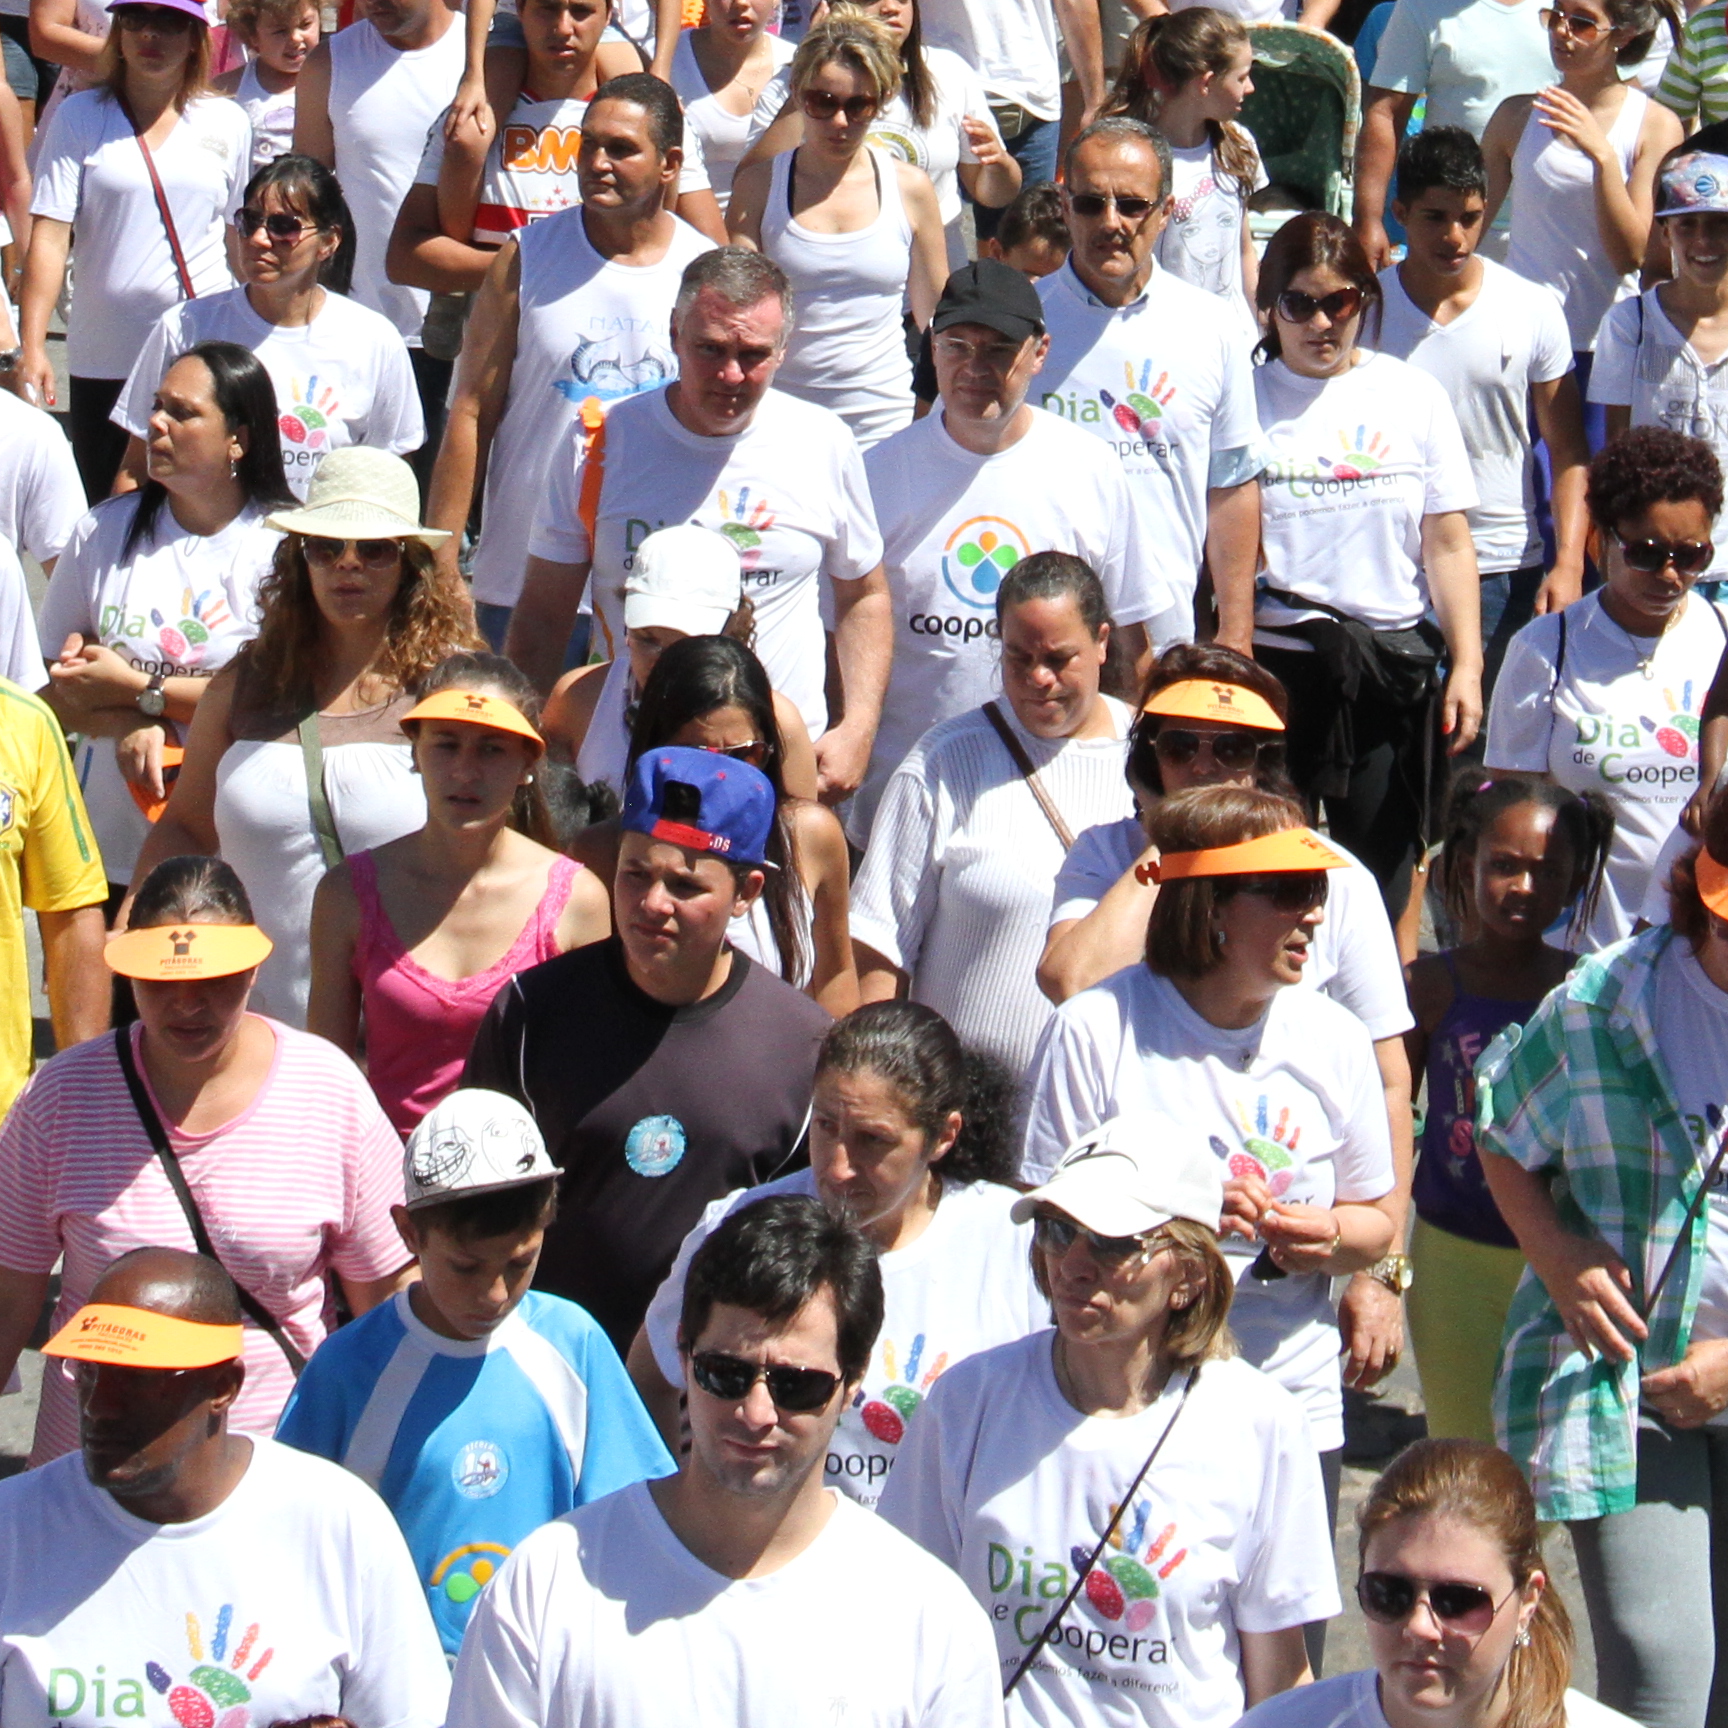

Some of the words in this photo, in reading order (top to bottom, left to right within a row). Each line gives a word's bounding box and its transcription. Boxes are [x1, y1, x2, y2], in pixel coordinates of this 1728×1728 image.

[501, 125, 582, 175] BM
[1108, 437, 1180, 459] perar
[1575, 714, 1641, 747] Dia
[1572, 750, 1595, 769] de
[1599, 752, 1703, 790] Coope
[987, 1541, 1071, 1600] Dia
[1013, 1604, 1177, 1670] Coopera
[1028, 1657, 1077, 1678] odemos
[48, 1664, 147, 1719] Dia
